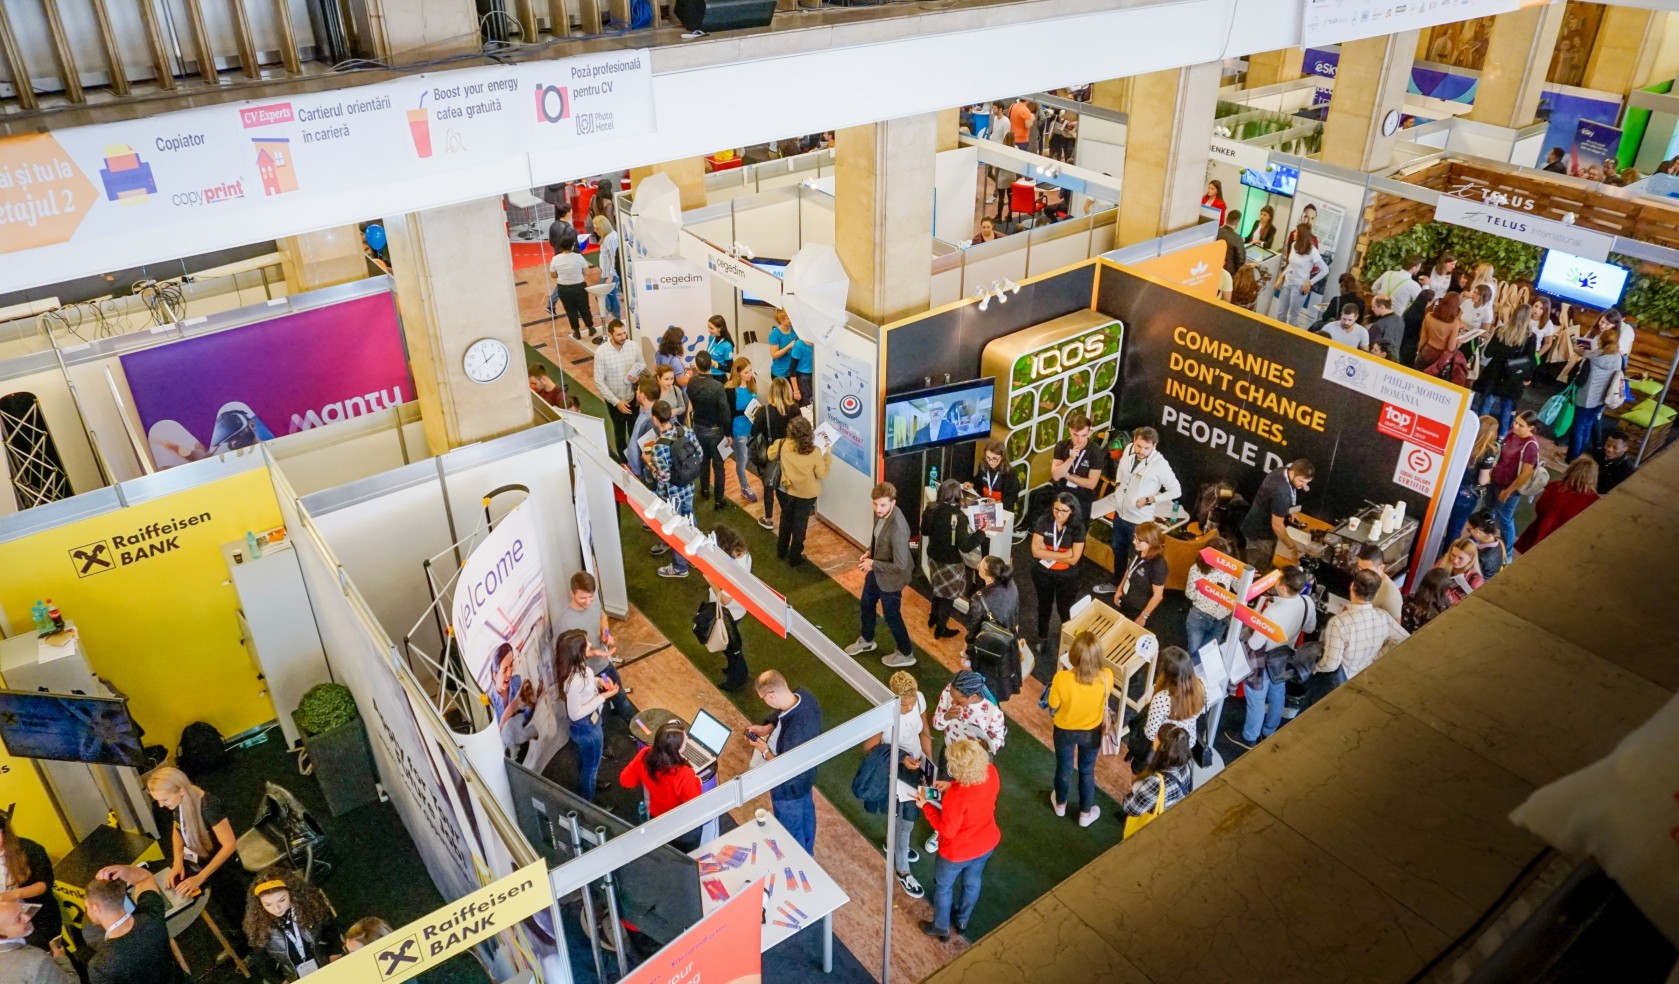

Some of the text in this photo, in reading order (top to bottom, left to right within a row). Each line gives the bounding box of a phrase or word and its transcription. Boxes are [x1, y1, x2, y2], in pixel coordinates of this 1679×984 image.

[571, 57, 641, 79] Poză profesională
[433, 77, 519, 101] Boost your energy
[573, 81, 613, 100] pentru CV
[244, 106, 291, 124] CV Experts
[298, 96, 391, 123] Cartierul orientării
[436, 98, 502, 121] cafea gratuită
[595, 111, 613, 121] Photo
[303, 124, 350, 143] în carieră
[595, 119, 614, 132] Hotel
[155, 132, 205, 153] Copiator
[1210, 145, 1236, 157] ENKER
[32, 163, 55, 182] tu
[52, 158, 74, 179] la
[60, 188, 75, 213] 2
[172, 178, 244, 207] copyprint
[1487, 215, 1527, 232] TELUS
[660, 273, 703, 285] cegedim
[716, 257, 746, 279] cegedim
[1173, 326, 1295, 389] COMPANIES
[1169, 352, 1327, 432] DON'T CHANGE
[1383, 374, 1452, 405] PHILIP MORRIS
[1165, 378, 1288, 446] INDUSTRIES.
[1385, 406, 1411, 427] top
[1161, 405, 1258, 467] PEOPLE
[112, 512, 211, 549] Raiffeisen
[121, 536, 180, 565] BANK
[1216, 556, 1237, 571] LEAD
[1204, 585, 1237, 606] CHANGE
[1250, 616, 1276, 634] GROW
[423, 879, 533, 940] Raiffeisen
[430, 912, 496, 957] BANK
